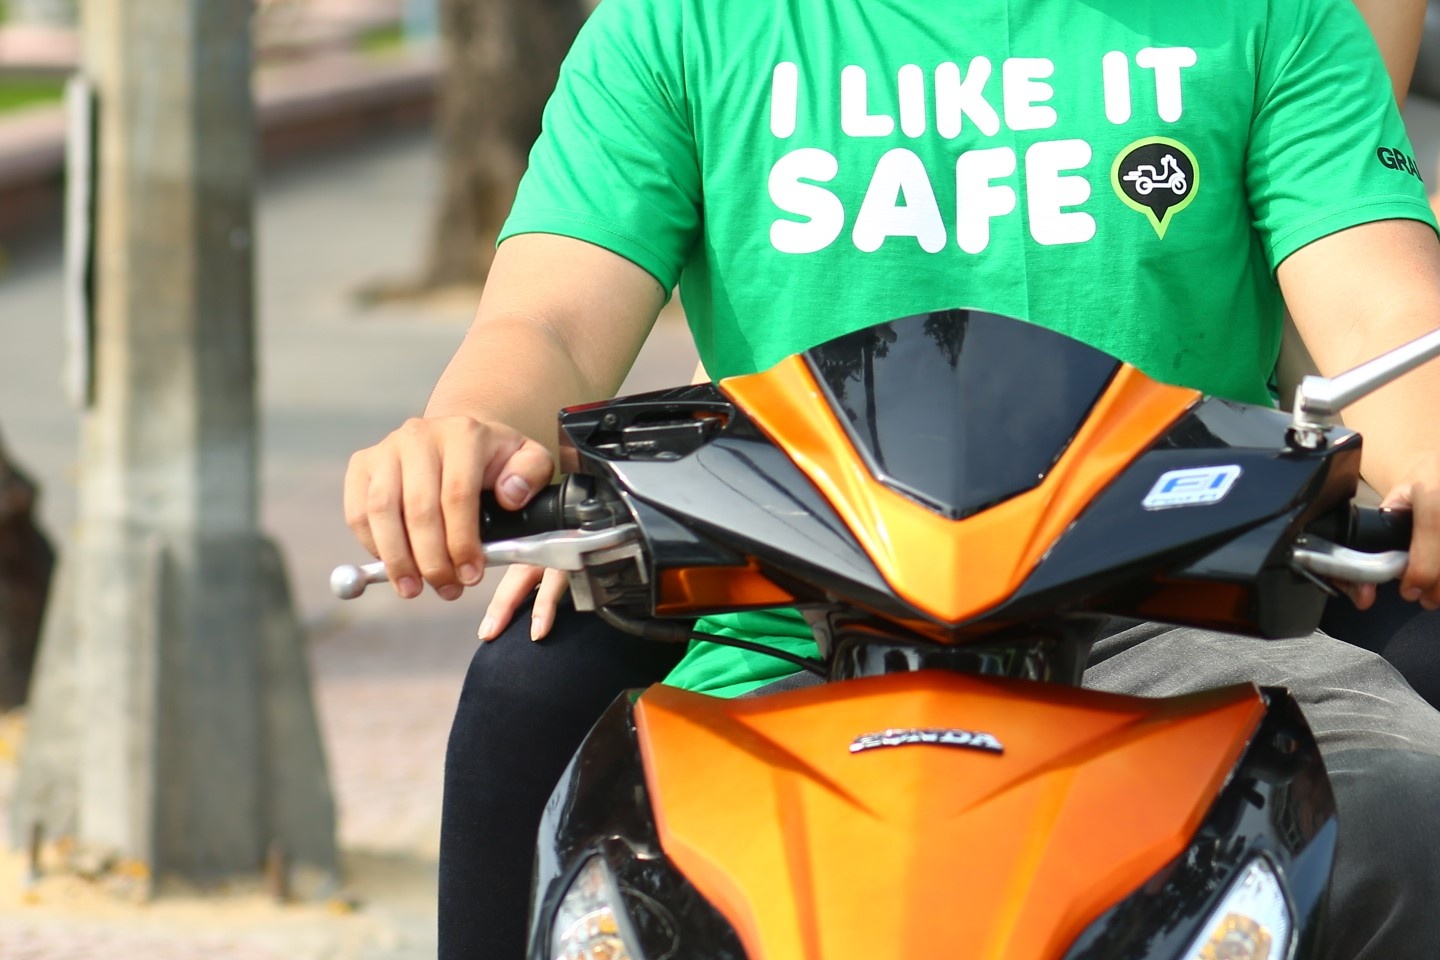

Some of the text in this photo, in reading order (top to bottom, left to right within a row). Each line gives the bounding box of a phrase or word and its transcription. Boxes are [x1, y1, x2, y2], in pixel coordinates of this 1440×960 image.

[769, 46, 1198, 140] I LIKE IT
[767, 138, 1097, 255] SAFE
